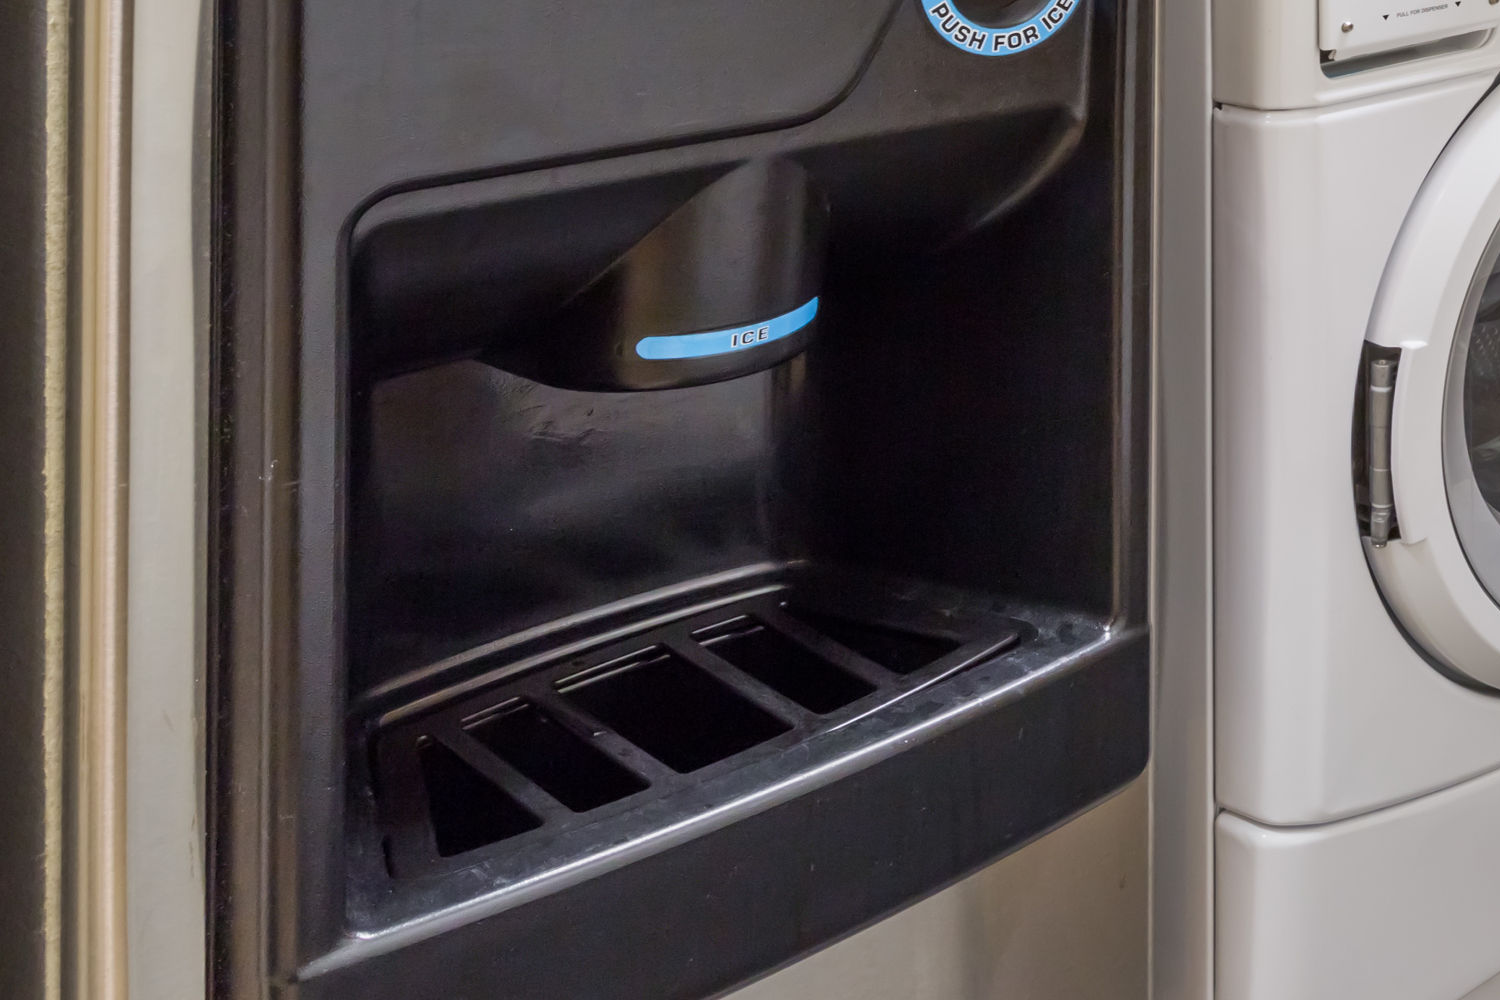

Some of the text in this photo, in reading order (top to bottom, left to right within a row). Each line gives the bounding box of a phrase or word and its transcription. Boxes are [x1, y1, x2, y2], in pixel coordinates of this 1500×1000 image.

[1421, 3, 1449, 13] DISPENSER
[931, 2, 987, 49] PUSH
[993, 25, 1040, 52] FOR
[731, 325, 770, 348] ICE
